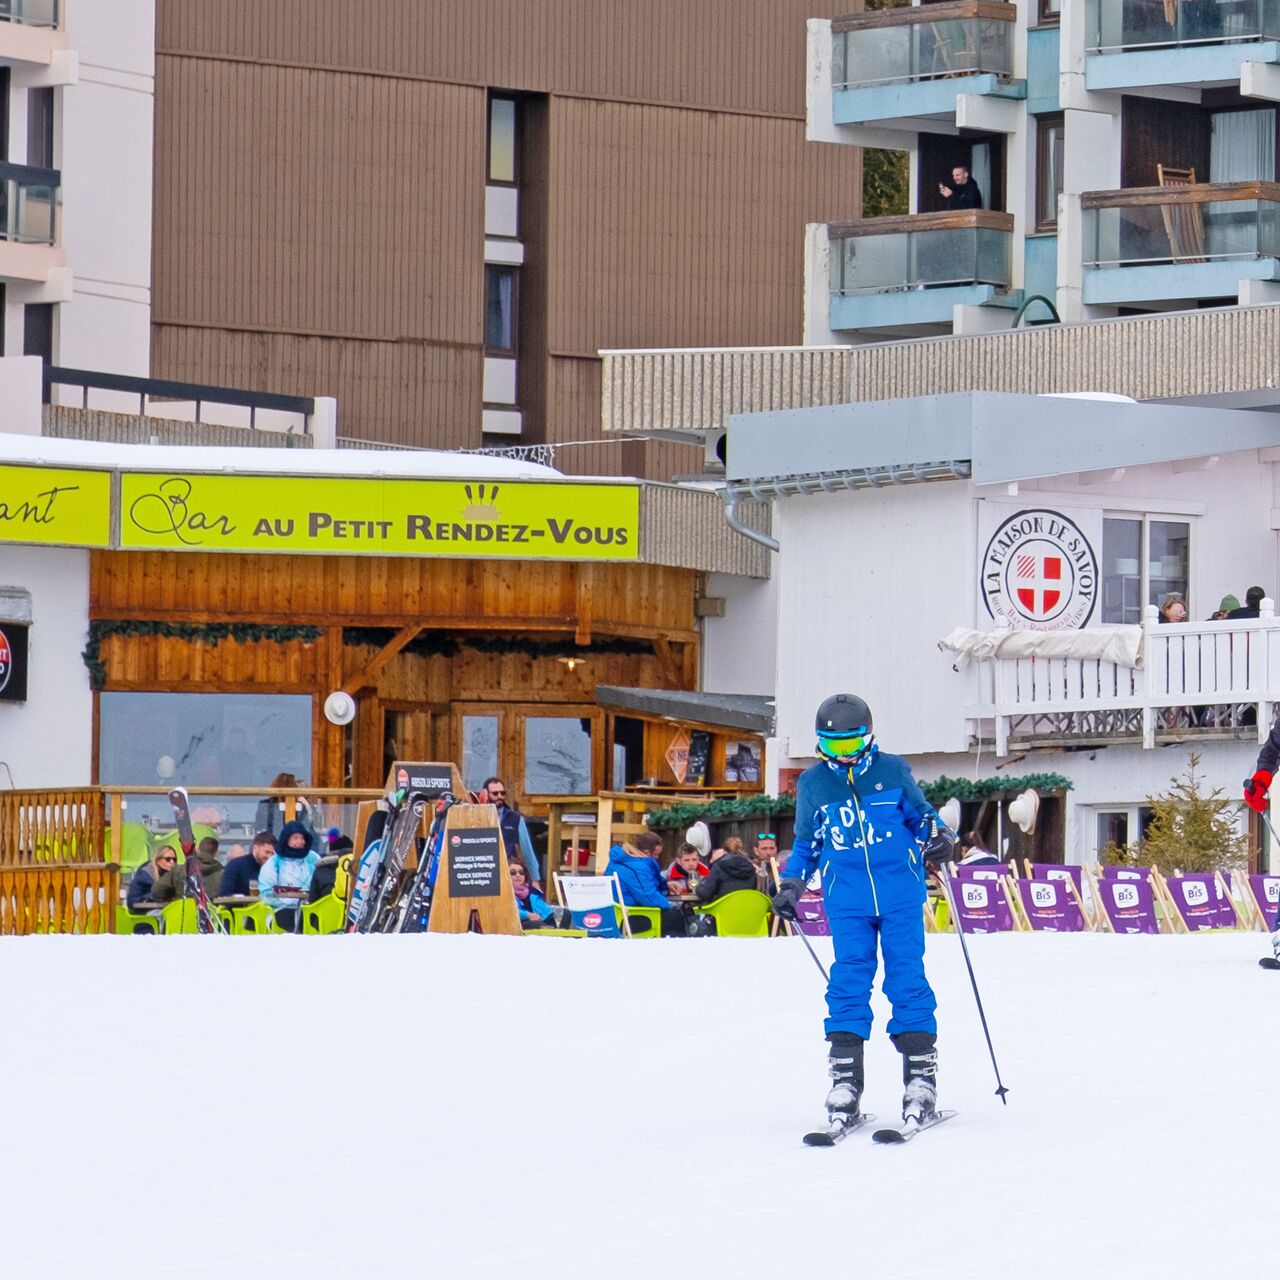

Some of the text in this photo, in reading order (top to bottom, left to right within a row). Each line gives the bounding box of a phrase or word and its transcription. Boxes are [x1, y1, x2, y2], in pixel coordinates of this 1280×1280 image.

[130, 477, 237, 545] Bar
[252, 518, 295, 537] AU
[986, 517, 1094, 602] LA MAISON DE SAVOY
